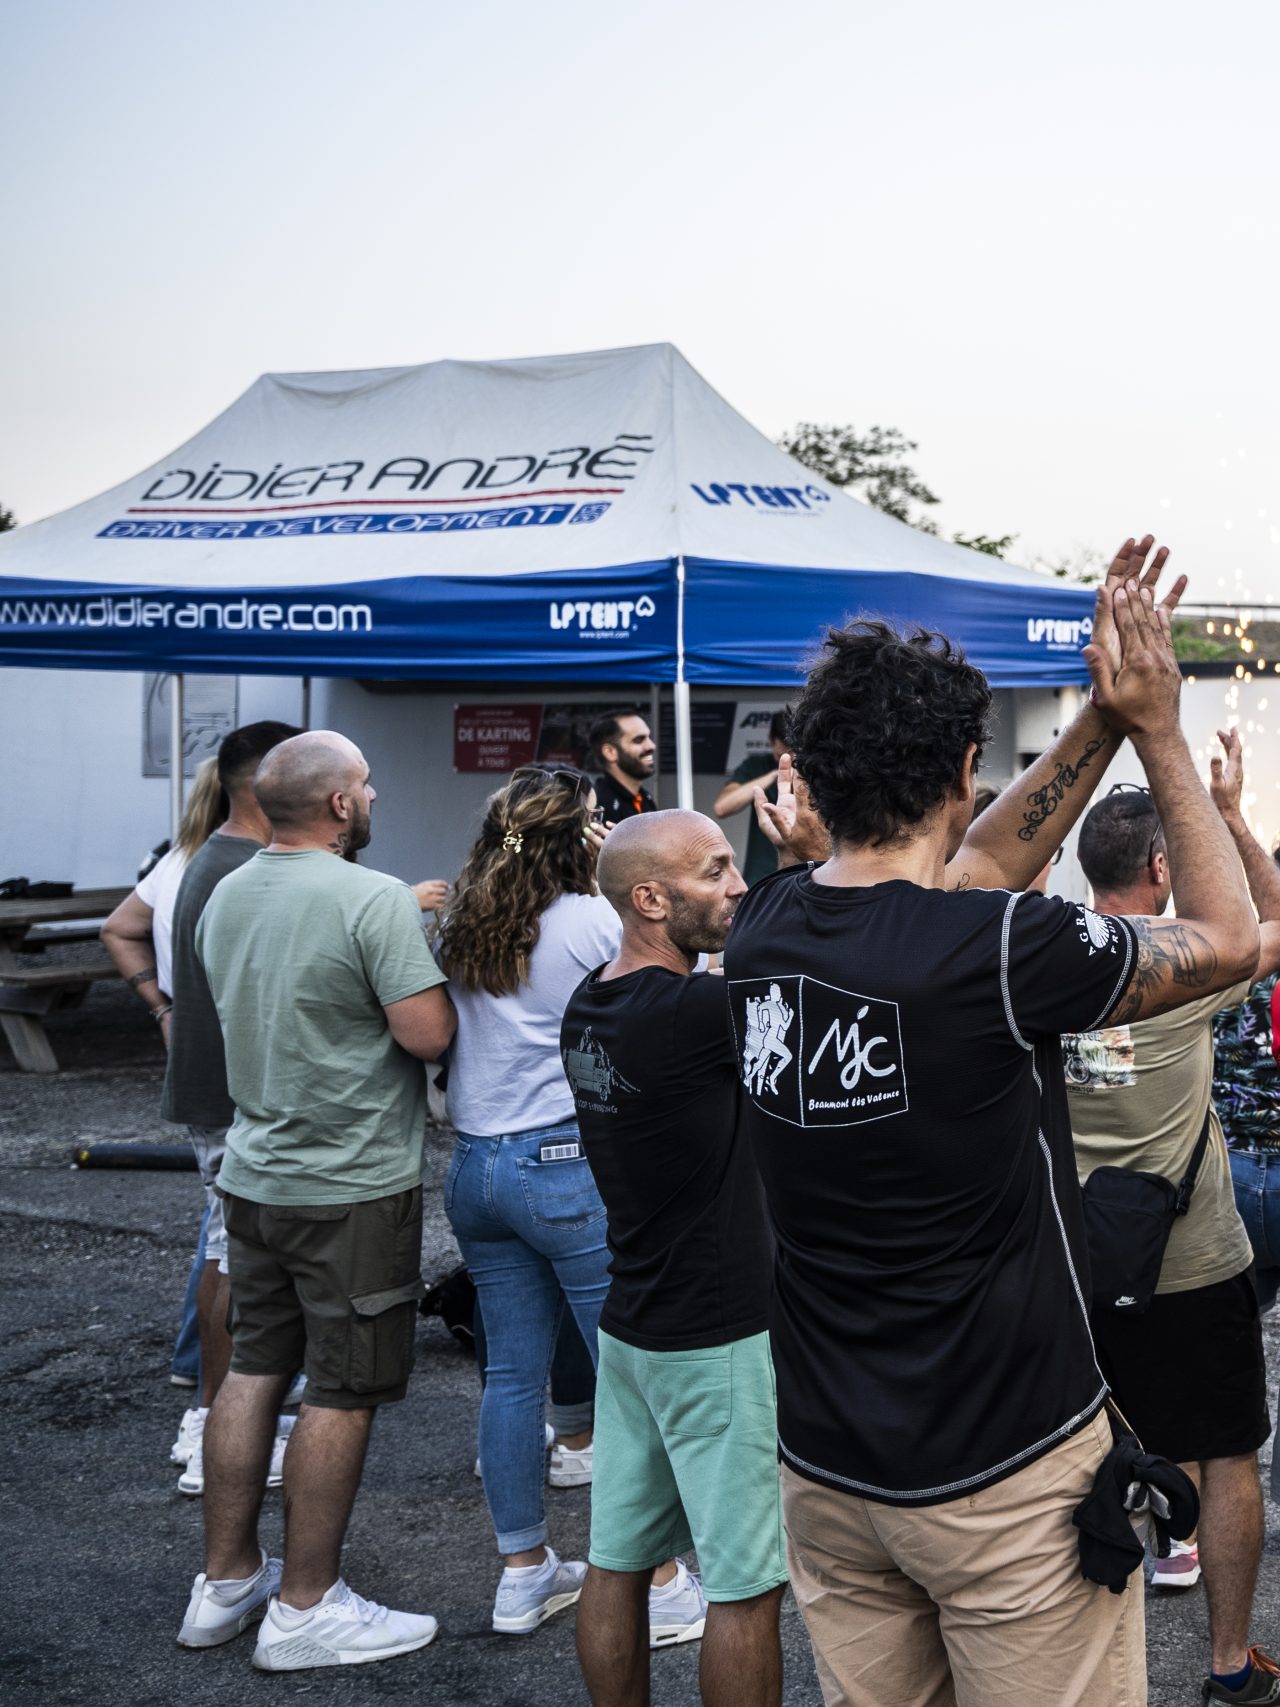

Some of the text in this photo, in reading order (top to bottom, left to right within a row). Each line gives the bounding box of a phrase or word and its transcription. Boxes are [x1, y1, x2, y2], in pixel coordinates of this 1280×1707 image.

[253, 506, 567, 537] DEVELOPMENT
[0, 598, 372, 631] www.didierandre.com
[550, 601, 635, 629] LPTENT
[458, 727, 531, 742] DE KARTING
[808, 1098, 849, 1111] Beaumont
[866, 1090, 900, 1104] Valence
